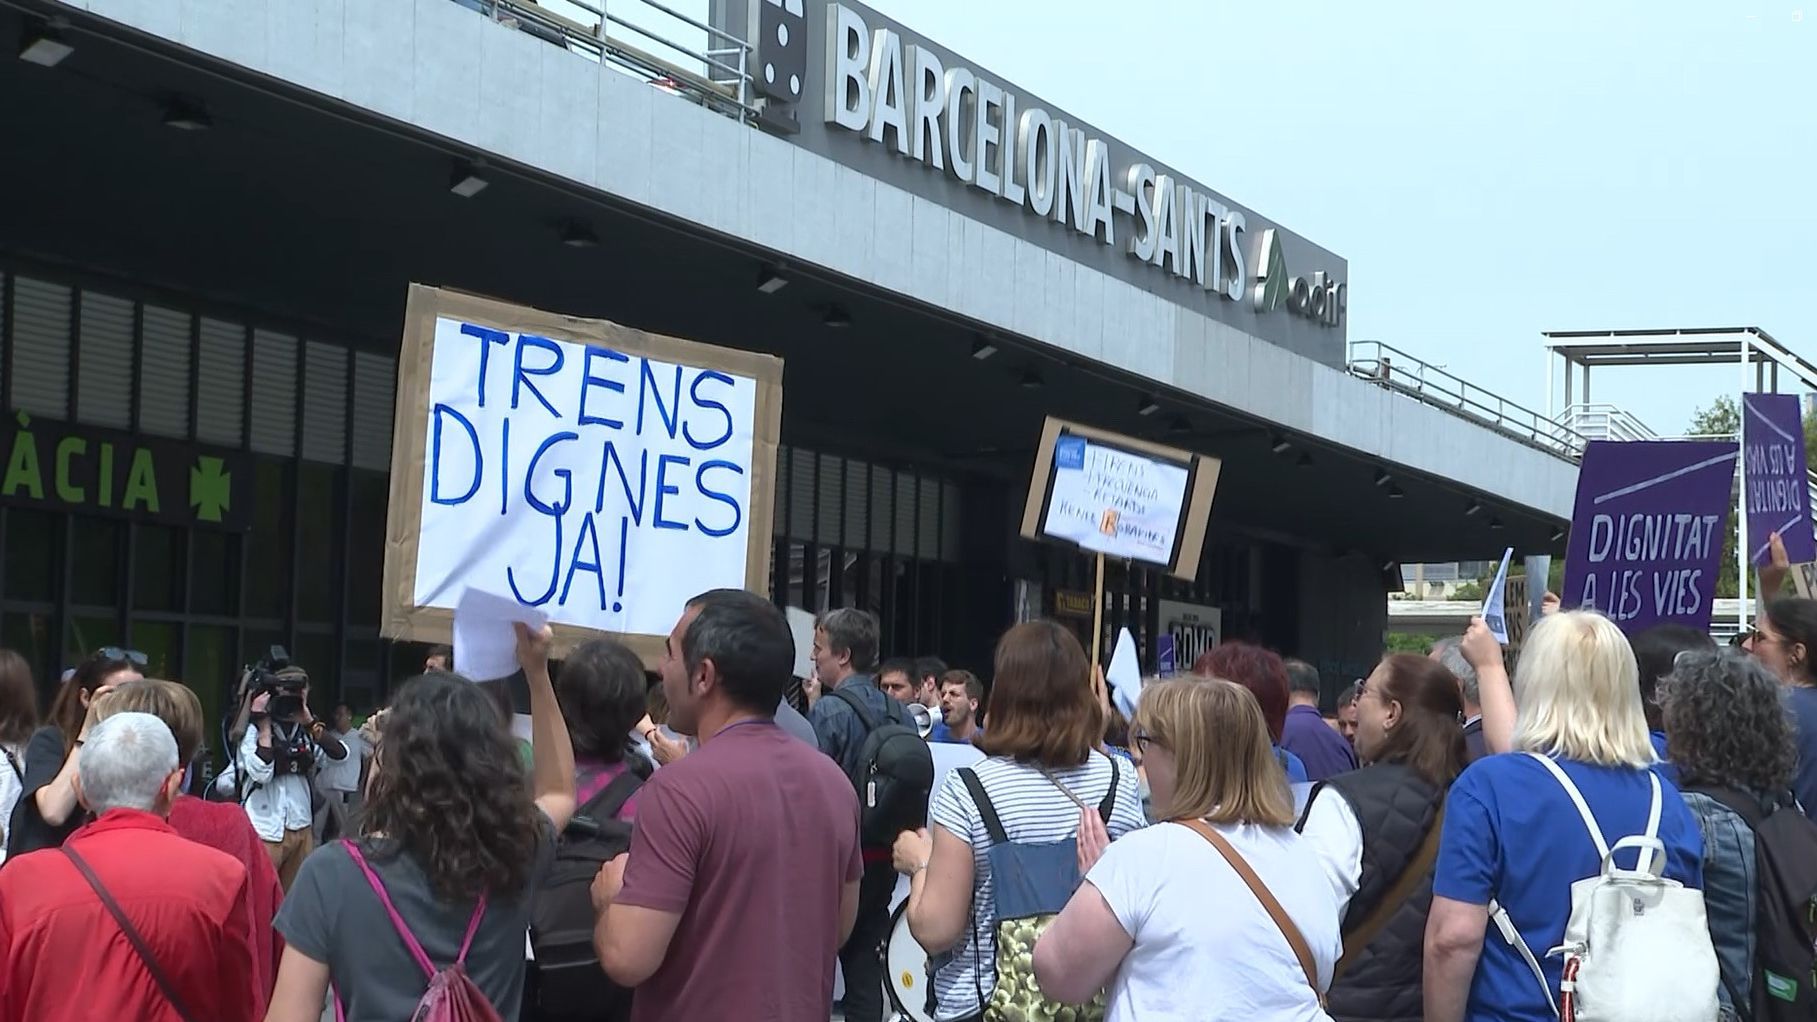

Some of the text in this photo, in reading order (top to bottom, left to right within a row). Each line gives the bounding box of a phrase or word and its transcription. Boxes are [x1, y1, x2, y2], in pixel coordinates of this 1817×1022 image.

[825, 2, 1247, 302] BARCELONA-SANTS
[460, 323, 735, 450] TRENS
[431, 403, 744, 537] DIGNES
[507, 501, 629, 612] JA!
[1580, 569, 1702, 621] A LES VIES
[1588, 513, 1719, 563] DIGNITAT
